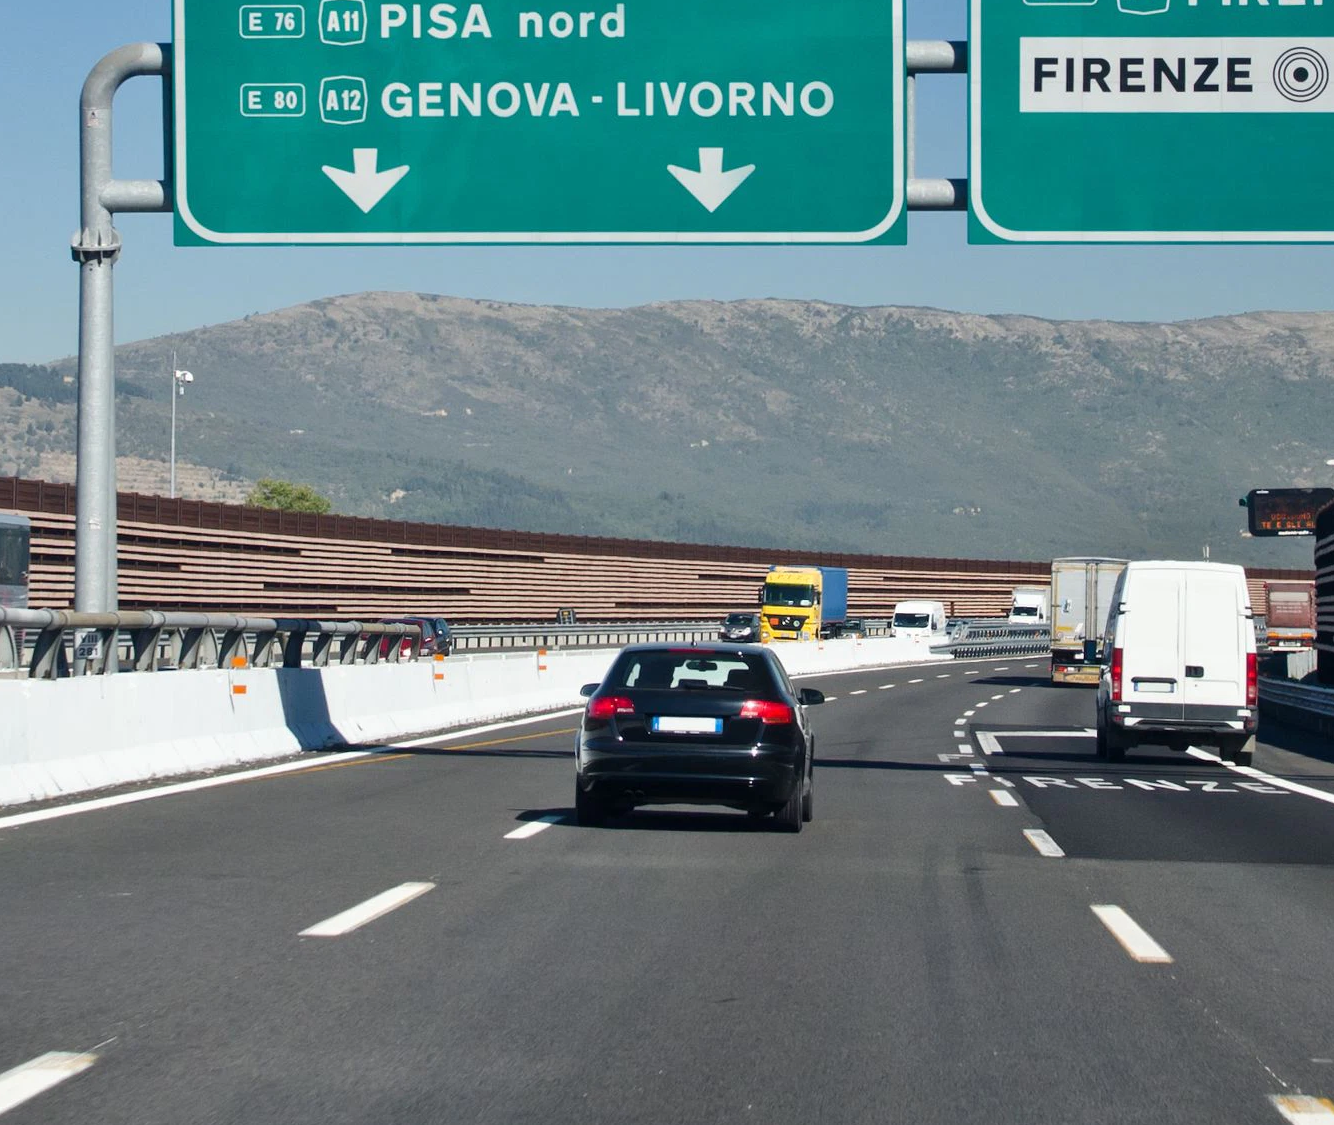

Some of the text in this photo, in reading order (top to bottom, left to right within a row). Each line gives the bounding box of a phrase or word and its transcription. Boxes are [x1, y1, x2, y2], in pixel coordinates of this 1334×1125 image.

[248, 12, 295, 32] E 76
[326, 10, 360, 32] A11
[380, 3, 625, 40] PISA nord
[1034, 57, 1253, 93] FIRENZE
[248, 90, 298, 110] E 80
[326, 89, 362, 111] A12
[381, 81, 580, 118] GENOVA
[617, 80, 834, 118] LIVORNO
[78, 647, 99, 656] 281
[943, 773, 1291, 795] FIRENZE
